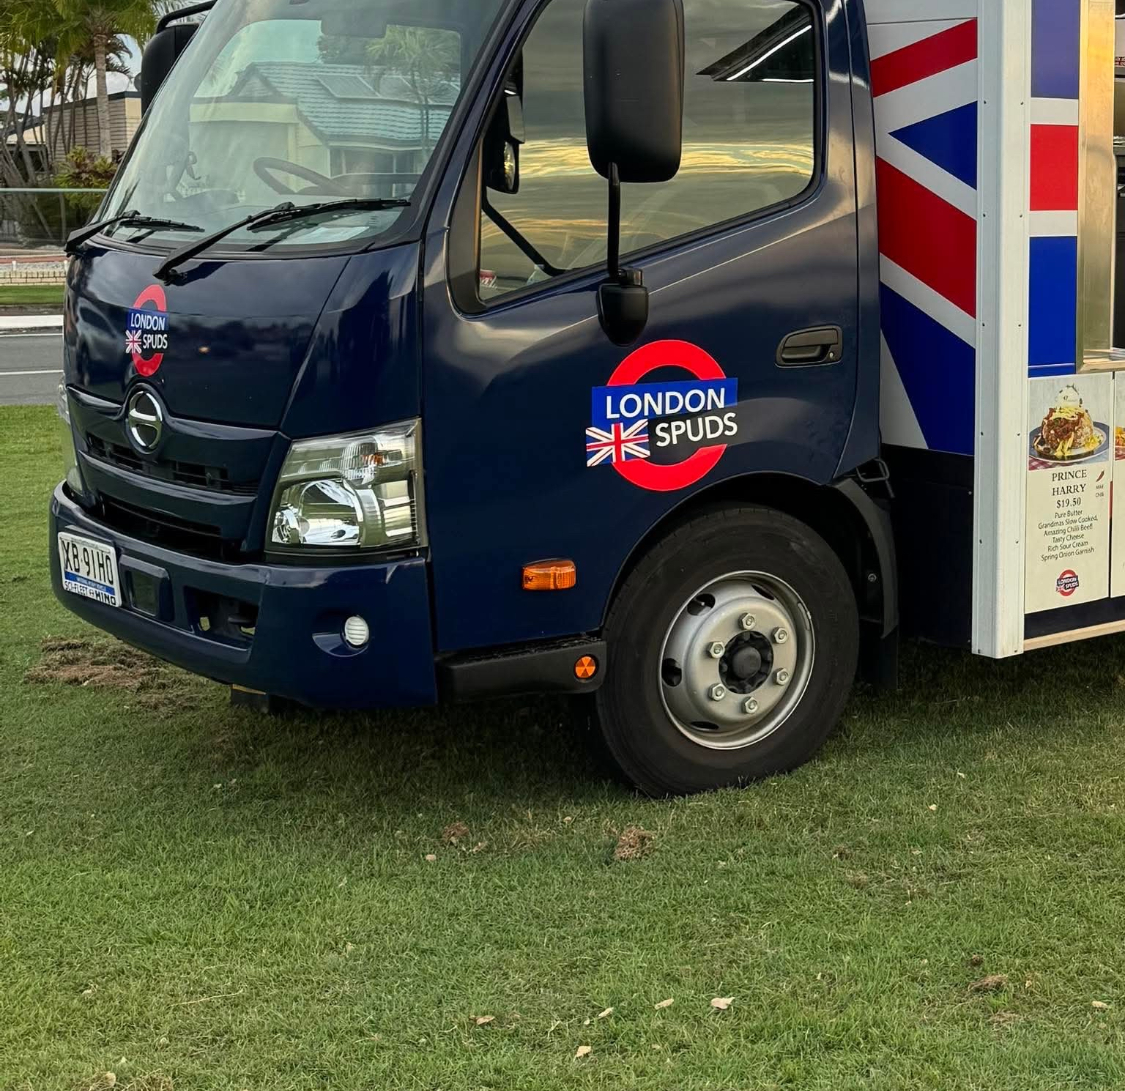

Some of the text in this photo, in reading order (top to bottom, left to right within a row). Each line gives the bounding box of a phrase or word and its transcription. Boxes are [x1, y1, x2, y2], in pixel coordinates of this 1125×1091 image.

[131, 313, 165, 330] LONDON
[143, 334, 168, 349] SPUDS
[606, 388, 725, 419] LONDON
[655, 412, 737, 447] SPUDS
[1052, 470, 1087, 482] PRINCE
[1052, 484, 1086, 496] HARRY
[1057, 497, 1081, 508] $19.50
[1044, 528, 1066, 536] Amazing
[1066, 533, 1084, 541] Cheese
[1041, 547, 1094, 561] Spring Onion Garnish
[95, 590, 116, 605] HINO
